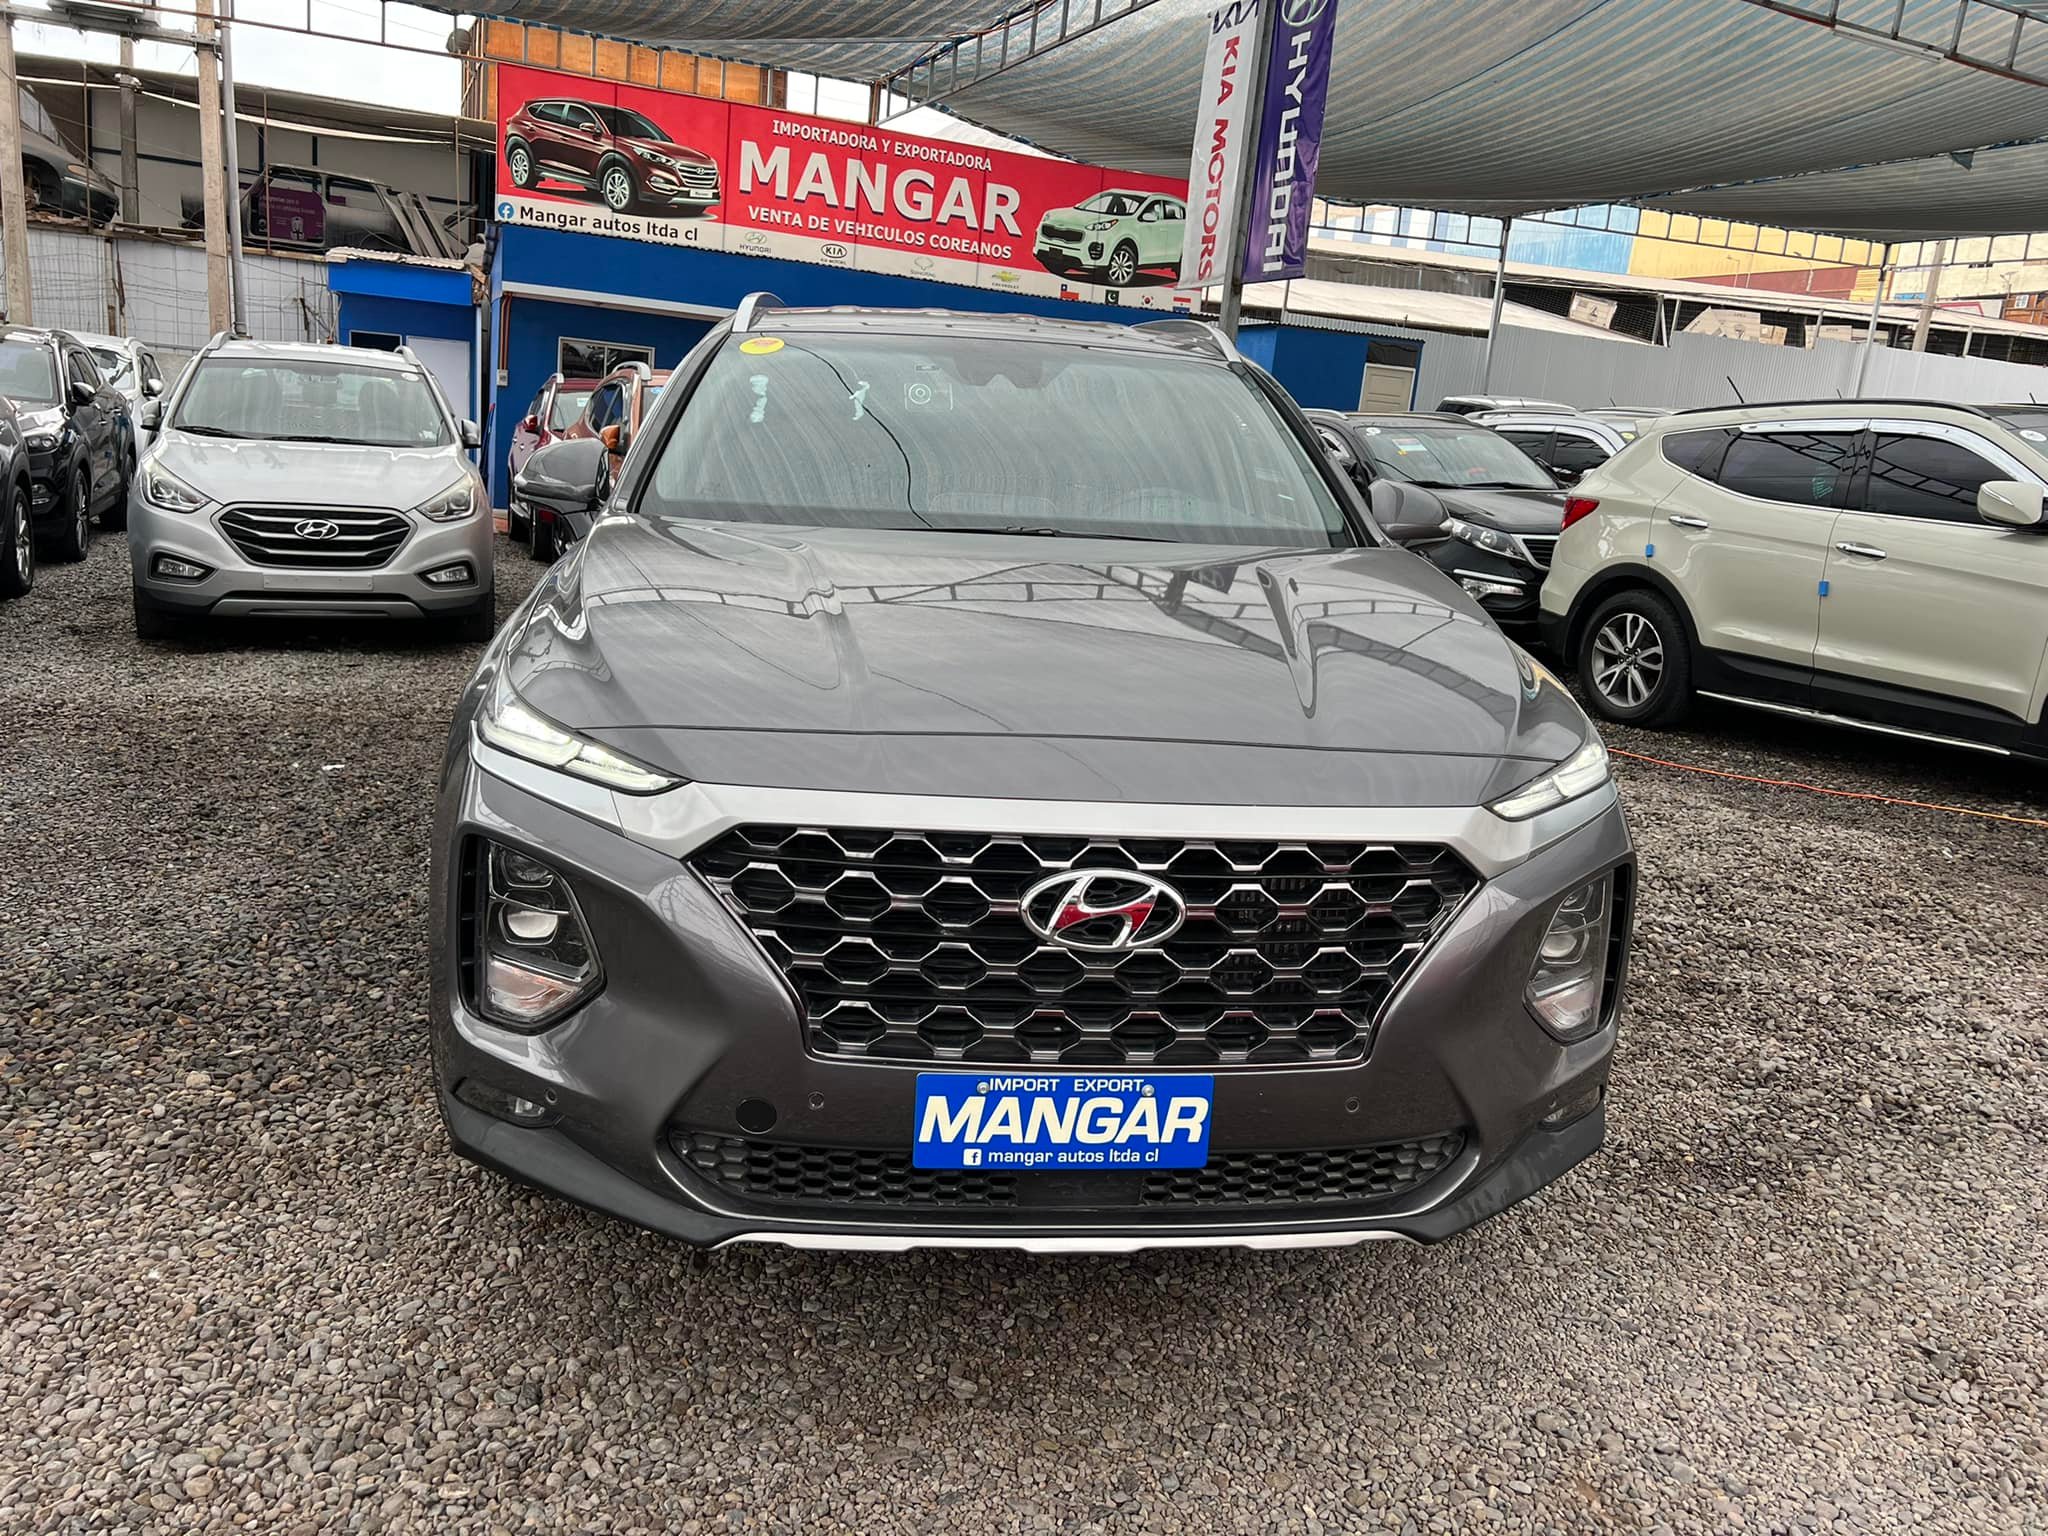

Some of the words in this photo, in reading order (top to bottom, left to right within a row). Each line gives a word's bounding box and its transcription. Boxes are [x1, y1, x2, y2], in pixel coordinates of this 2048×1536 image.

[1217, 36, 1240, 106] KIA
[772, 119, 878, 152] IMPORTADORA
[881, 138, 890, 153] Y
[894, 141, 992, 172] EXPORTADORA
[1263, 31, 1312, 273] HYUNDAI
[739, 140, 1023, 236] MANGAR
[1199, 118, 1230, 281] MOTORS
[519, 205, 587, 228] Mangar
[592, 214, 641, 235] autos
[646, 221, 679, 240] ltda
[684, 226, 698, 242] cl
[748, 205, 803, 228] VENTA
[807, 214, 829, 232] DE
[834, 219, 926, 246] VEHICULOS
[929, 234, 1012, 260] COREANOS
[825, 246, 843, 256] KIA
[989, 1078, 1060, 1092] IMPORT
[1073, 1079, 1144, 1093] EXPORT
[918, 1095, 1209, 1144] MANGAR
[988, 1152, 1053, 1166] mangar
[1057, 1150, 1105, 1164] autos
[1109, 1149, 1140, 1163] ltda
[1145, 1148, 1159, 1163] cl
